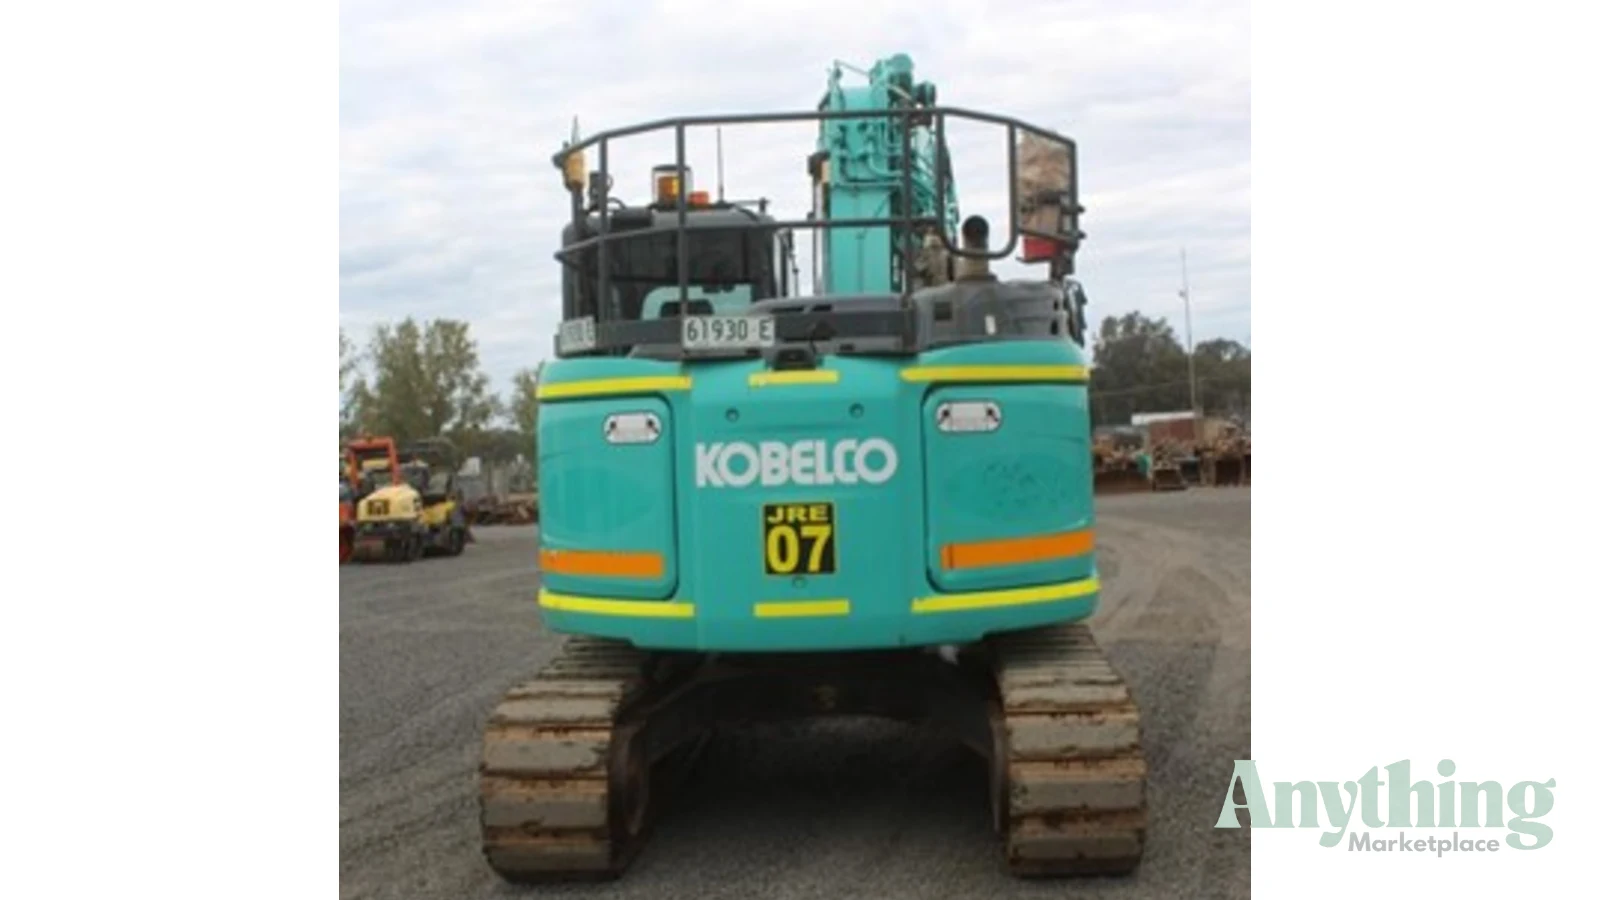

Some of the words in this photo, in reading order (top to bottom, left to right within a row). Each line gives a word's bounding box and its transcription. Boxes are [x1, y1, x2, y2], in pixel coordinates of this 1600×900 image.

[687, 319, 749, 341] 61930
[759, 318, 773, 340] E
[696, 438, 898, 488] KOBELCO
[768, 505, 828, 522] JRE
[767, 525, 831, 573] 07
